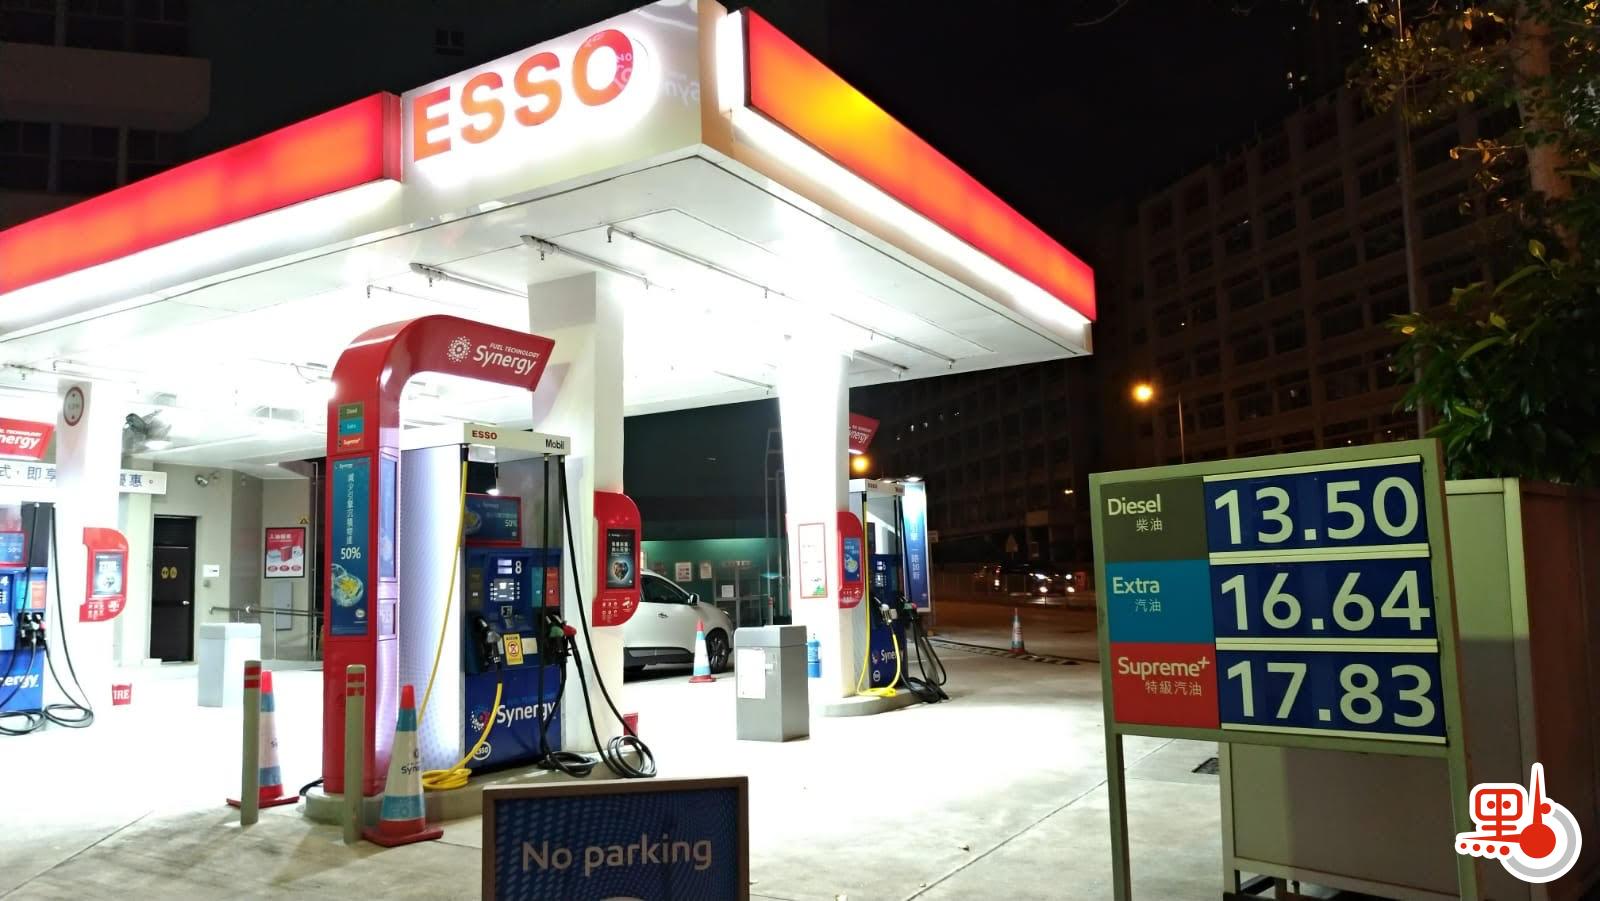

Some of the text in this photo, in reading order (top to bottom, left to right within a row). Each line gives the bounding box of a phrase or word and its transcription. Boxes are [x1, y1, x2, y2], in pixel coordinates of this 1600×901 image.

[412, 29, 634, 162] ESSO
[473, 345, 536, 375] Synergy
[490, 342, 540, 358] FUEL TECHNOLOGY
[472, 430, 565, 449] ESSO Mobil
[1107, 494, 1162, 516] Diesel
[1214, 476, 1420, 545] 13.50
[1136, 517, 1163, 532] 柴油
[341, 547, 361, 560] 50%
[515, 560, 522, 574] 8
[1112, 576, 1161, 594] Extra
[1135, 598, 1161, 613] 汽油
[1220, 570, 1431, 632] 16.64
[1117, 656, 1211, 681] Supreme+
[1144, 681, 1202, 697] 特級汽油
[1226, 660, 1436, 728] 17.83
[522, 832, 712, 877] No parking
